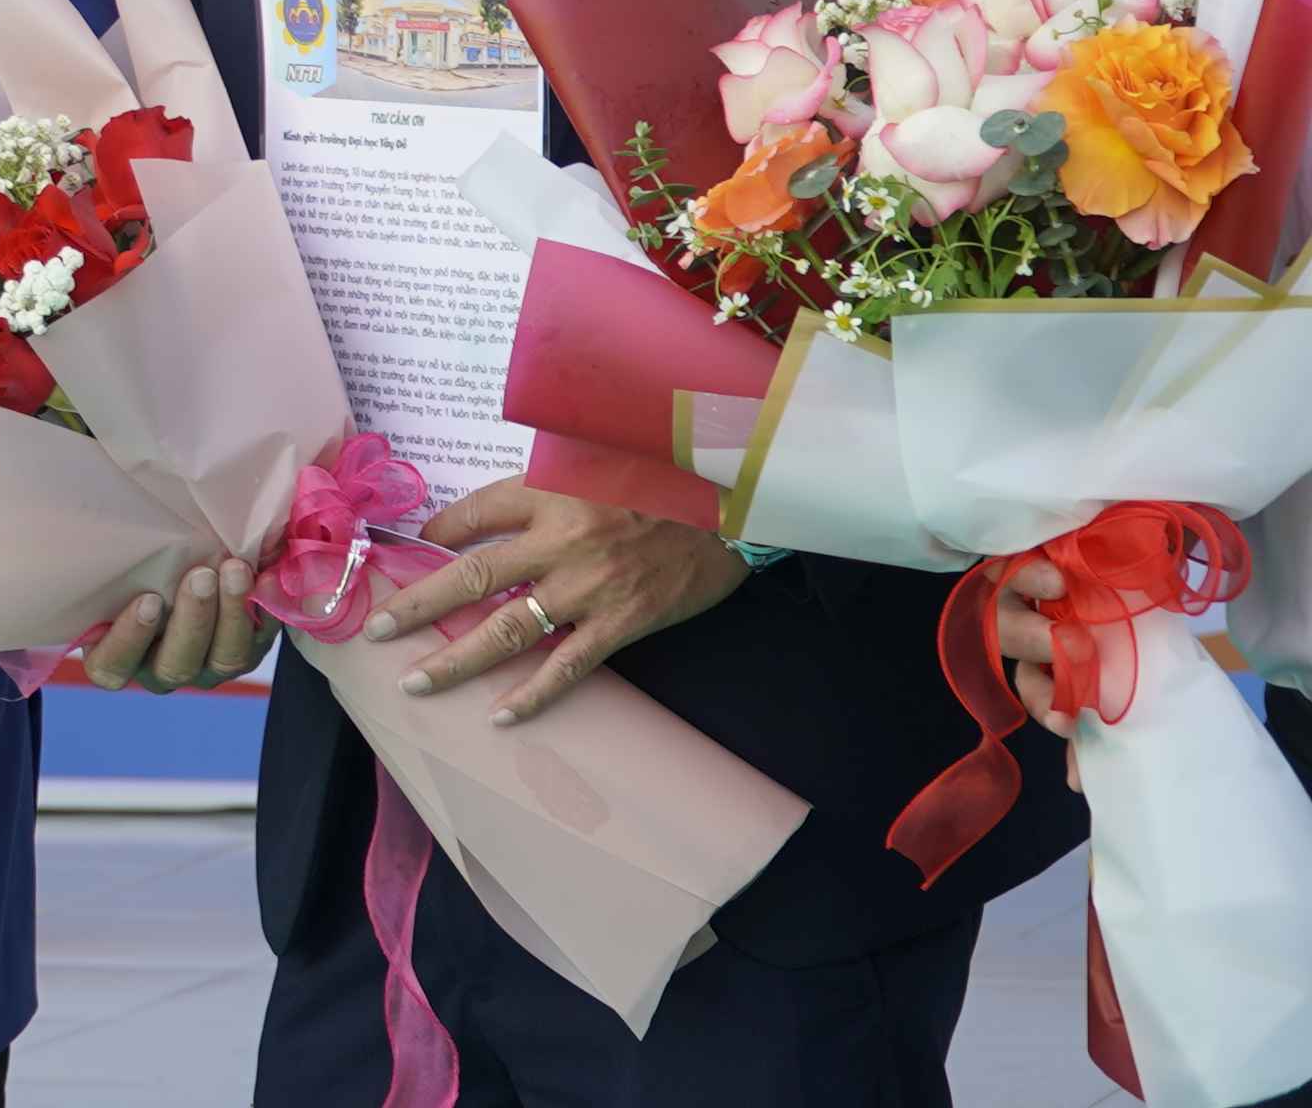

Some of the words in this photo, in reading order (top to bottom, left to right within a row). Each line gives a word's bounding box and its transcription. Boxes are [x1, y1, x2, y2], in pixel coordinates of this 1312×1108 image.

[390, 432, 405, 446] đẹp
[405, 434, 425, 446] nhất
[425, 436, 436, 447] tới
[436, 438, 455, 453] Quý
[455, 440, 473, 452] đơn
[473, 442, 482, 455] vị
[483, 443, 494, 454] và
[495, 445, 525, 459] mong
[401, 450, 409, 462] vị
[410, 452, 432, 466] trong
[432, 454, 447, 465] các
[447, 455, 467, 468] hoạt
[467, 457, 491, 473] động
[491, 459, 525, 474] hướng
[434, 483, 460, 500] tháng
